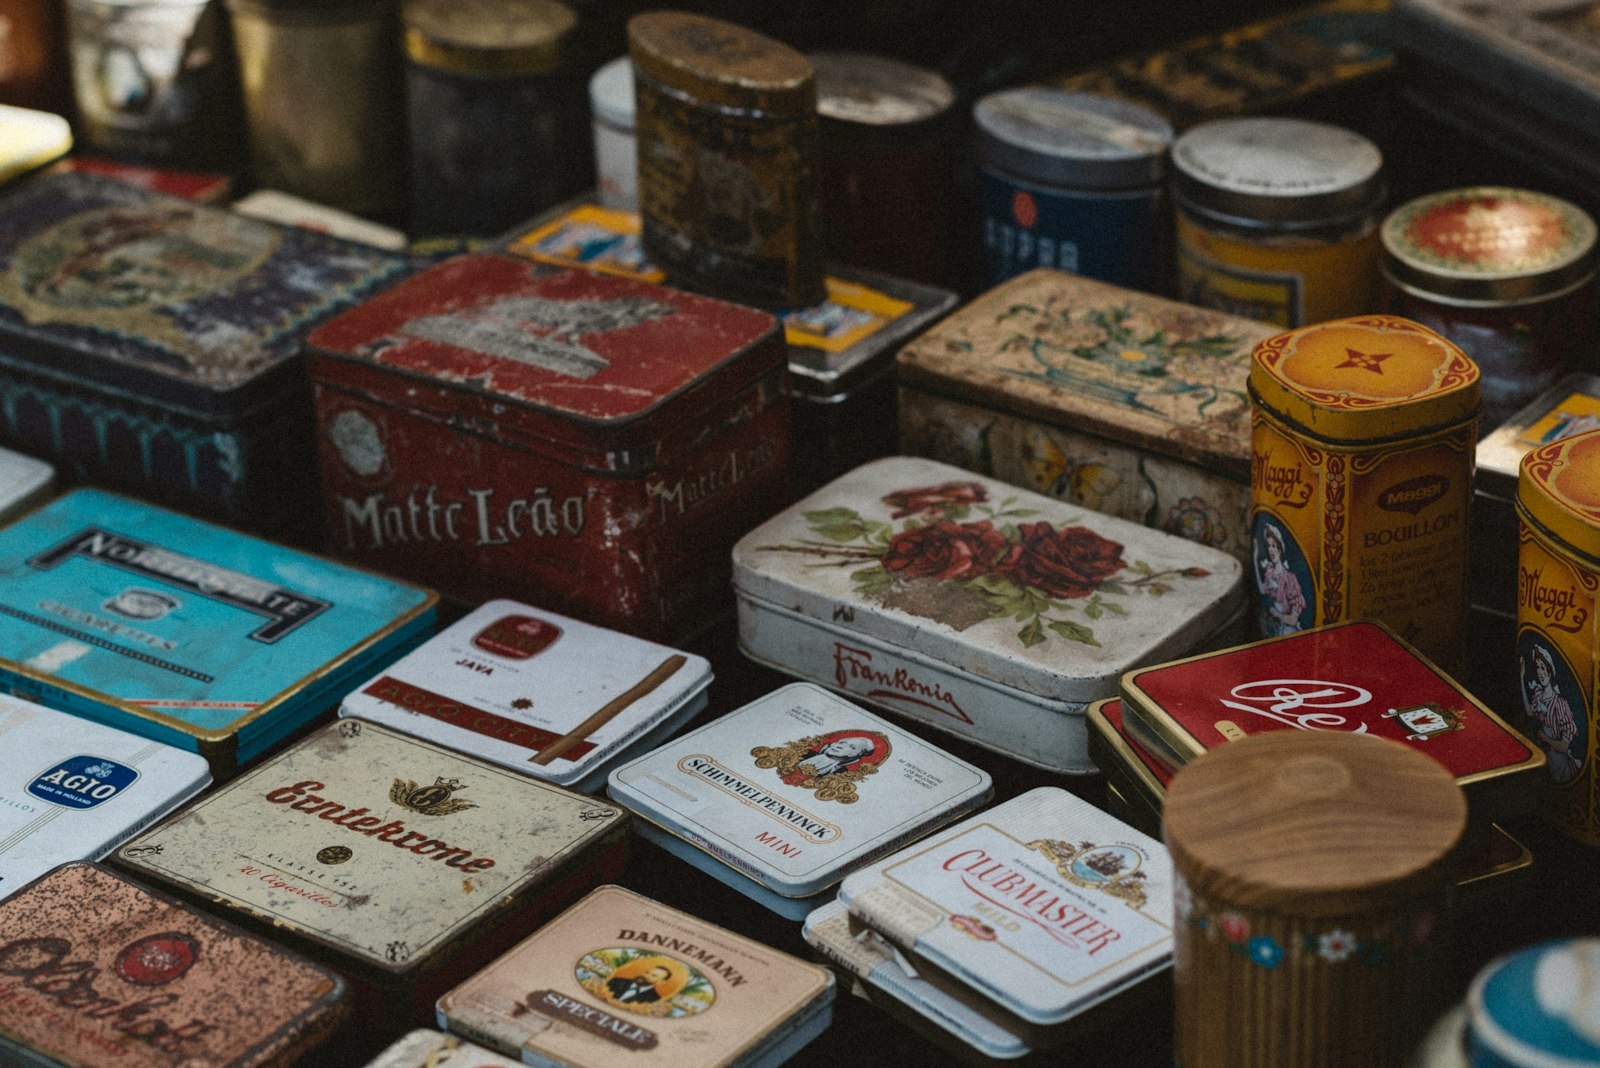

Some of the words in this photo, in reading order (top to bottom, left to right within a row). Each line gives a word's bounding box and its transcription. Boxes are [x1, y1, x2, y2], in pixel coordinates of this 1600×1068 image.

[1253, 448, 1304, 498] Maggi
[336, 484, 463, 550] Matte
[467, 486, 586, 546] Leão
[1364, 513, 1459, 548] BOUILLON
[1519, 565, 1577, 622] Maggi
[455, 658, 495, 676] JAVA
[832, 641, 960, 708] Frankonia
[378, 685, 460, 718] AGIO
[472, 716, 549, 746] CITY
[36, 784, 55, 793] MADE
[62, 793, 92, 805] HOLLAND
[41, 768, 117, 800] AGIO
[687, 758, 832, 840] SCHIMMELPENNINCK
[264, 780, 497, 877] Erntekrone
[754, 831, 804, 859] MINI
[238, 865, 262, 876] 20
[259, 873, 339, 908] Cigarillos
[266, 853, 327, 880] KLASSE
[333, 878, 358, 891] 152
[941, 849, 1122, 956] CLUBMASTER
[615, 928, 748, 988] DANNEMANN
[542, 991, 651, 1045] SPECIALE
